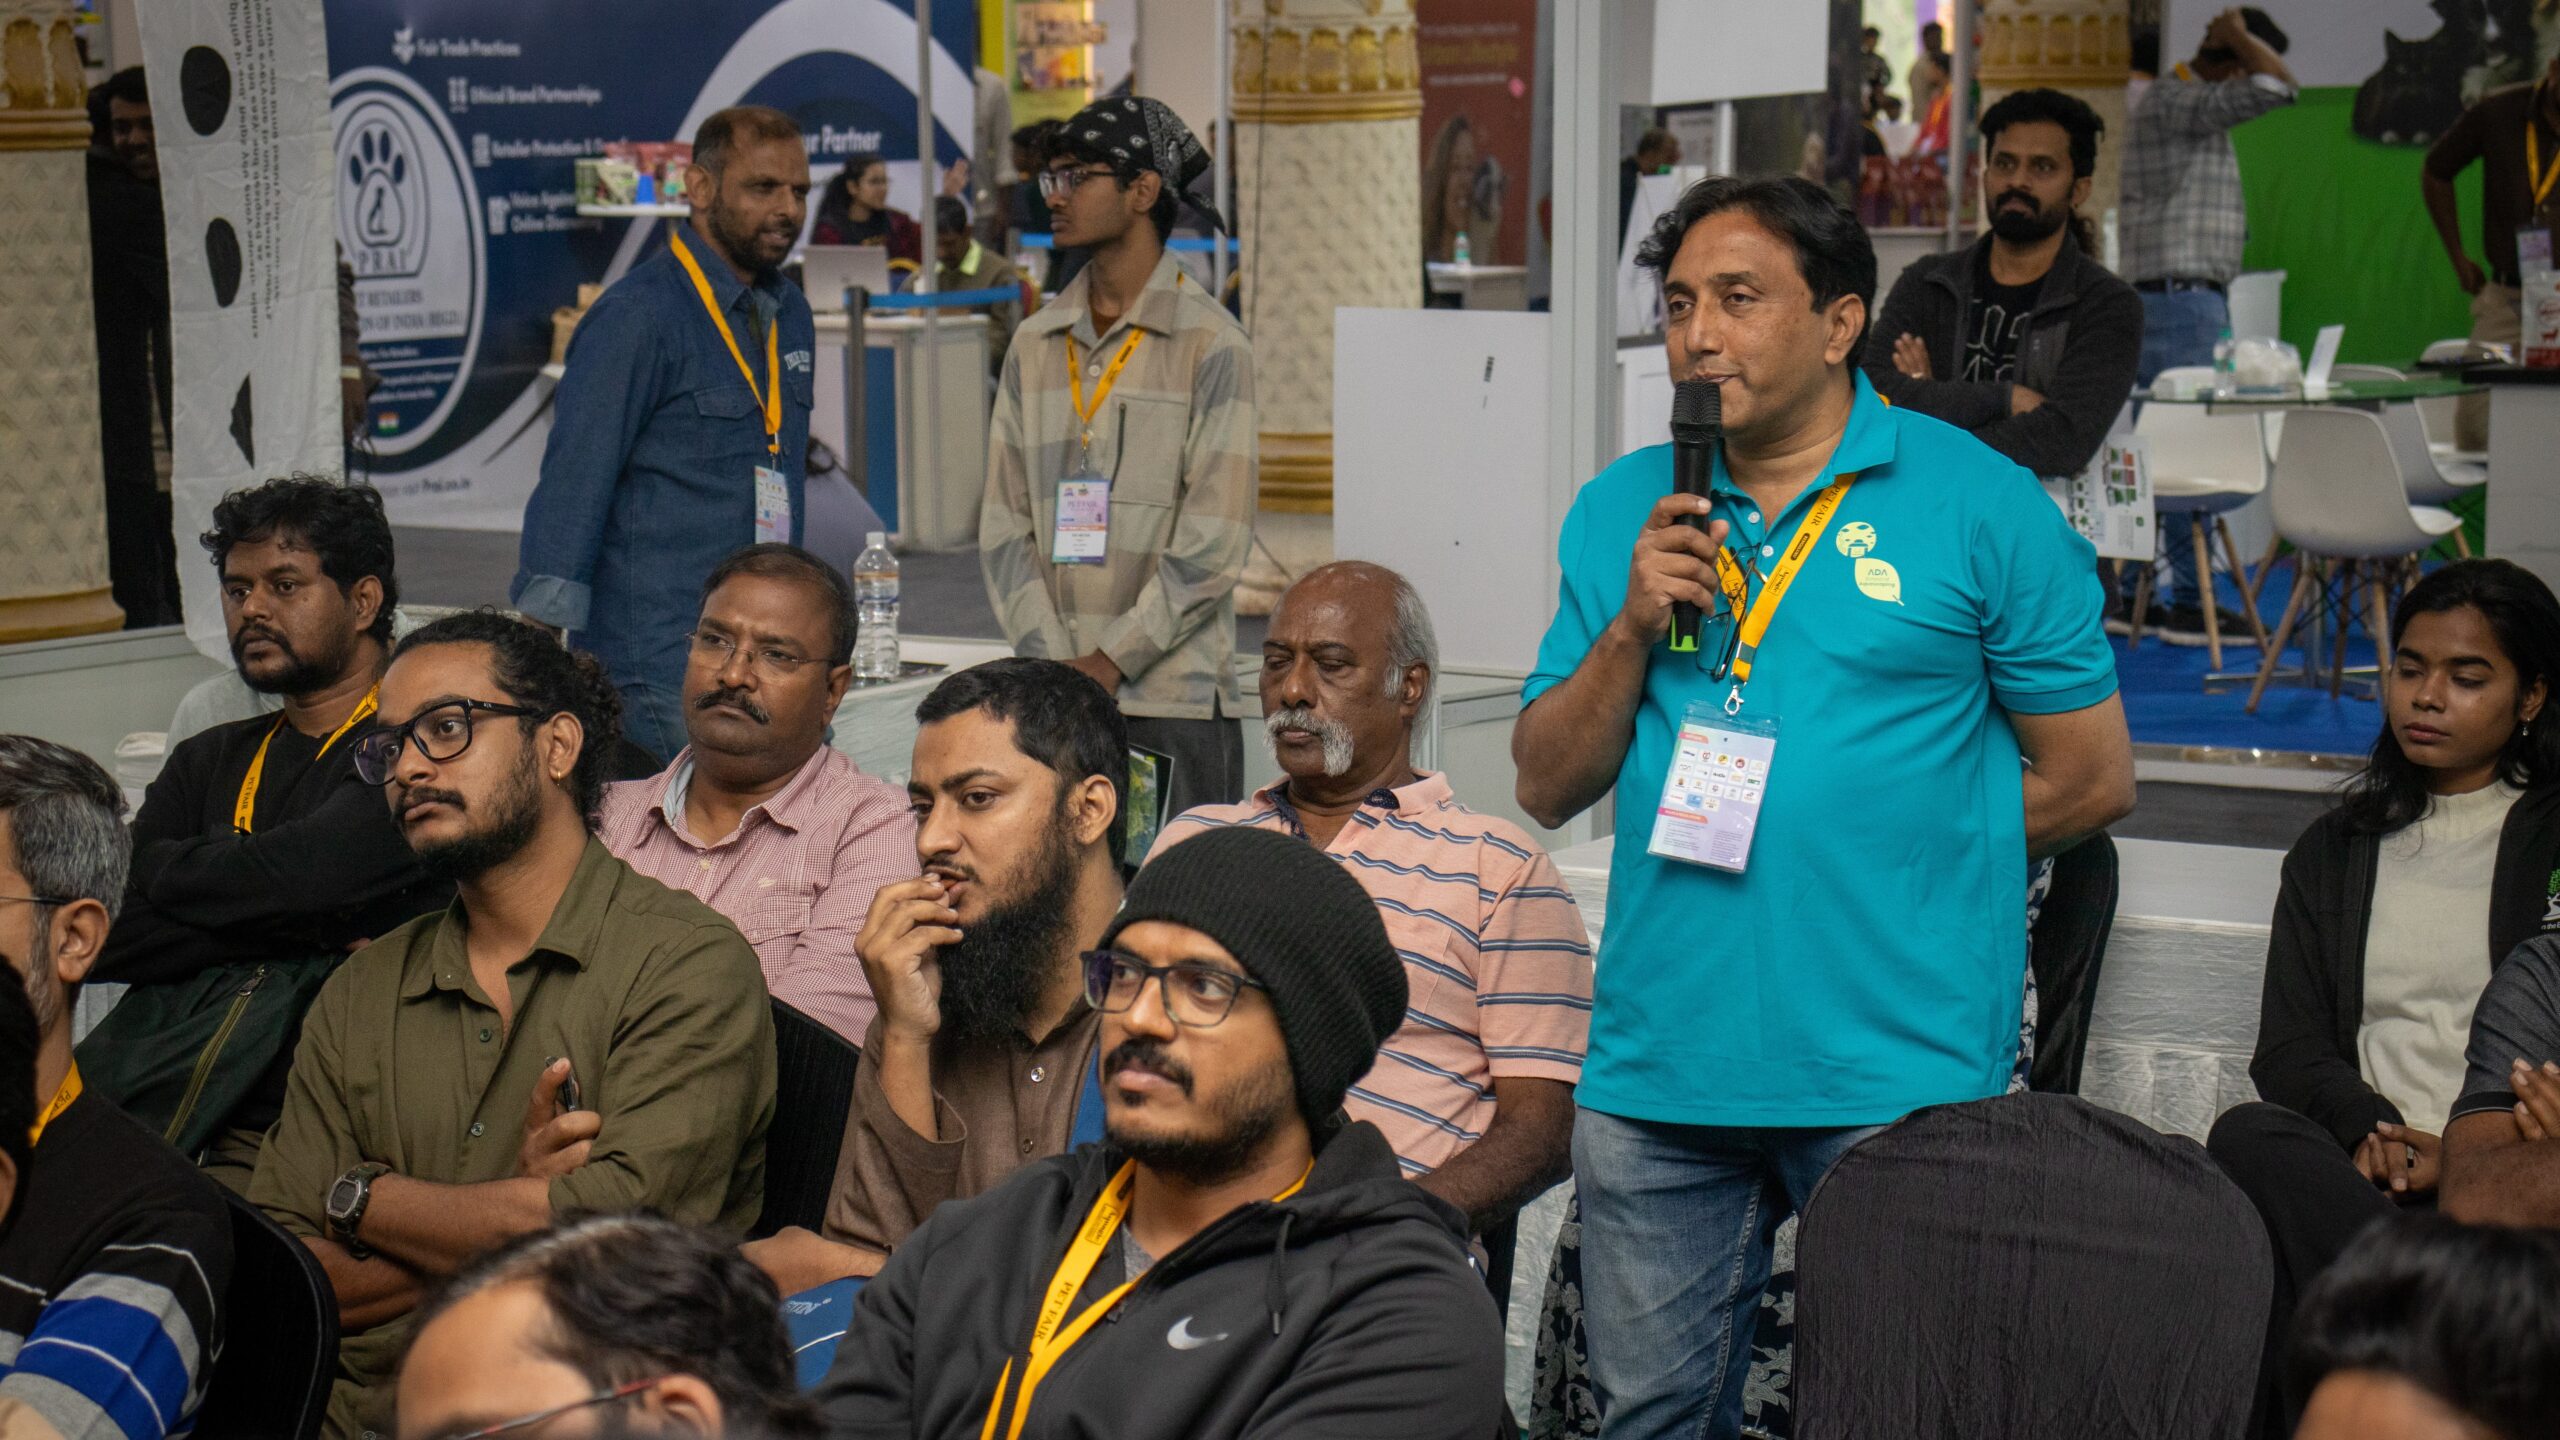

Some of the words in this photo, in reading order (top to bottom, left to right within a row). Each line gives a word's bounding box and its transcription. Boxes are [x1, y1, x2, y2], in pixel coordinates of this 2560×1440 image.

[821, 125, 881, 153] Partner
[359, 248, 407, 273] PRAI
[1824, 484, 1840, 504] PET
[1810, 503, 1829, 527] FAIR
[246, 776, 255, 790] PET
[241, 792, 251, 809] FAIR
[1054, 1281, 1074, 1306] PET
[1036, 1311, 1057, 1340] FAIR
